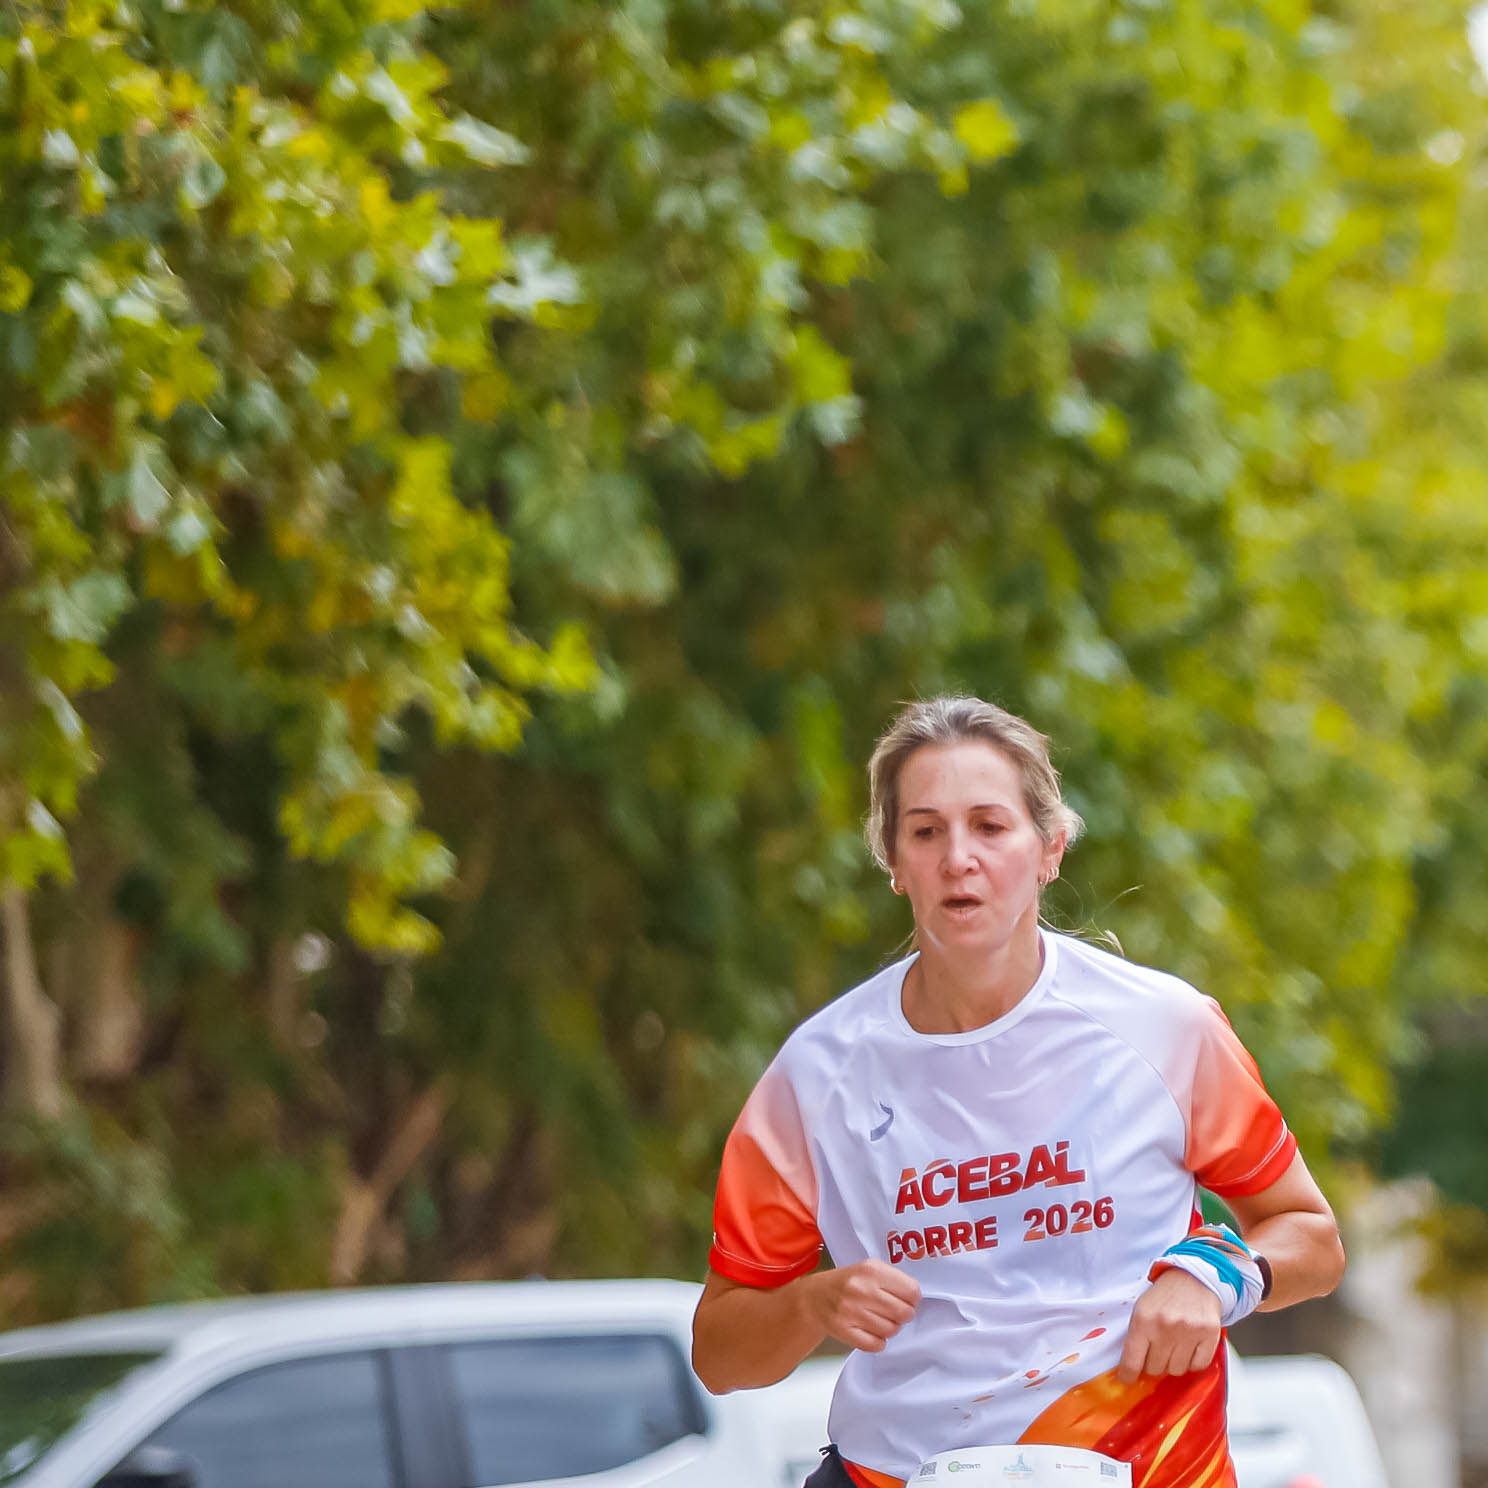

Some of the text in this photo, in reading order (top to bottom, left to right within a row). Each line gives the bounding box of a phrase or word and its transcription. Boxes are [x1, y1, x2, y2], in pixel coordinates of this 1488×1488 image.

[895, 1140, 1086, 1215] ACEBAL
[886, 1196, 1115, 1264] CORRE 2026
